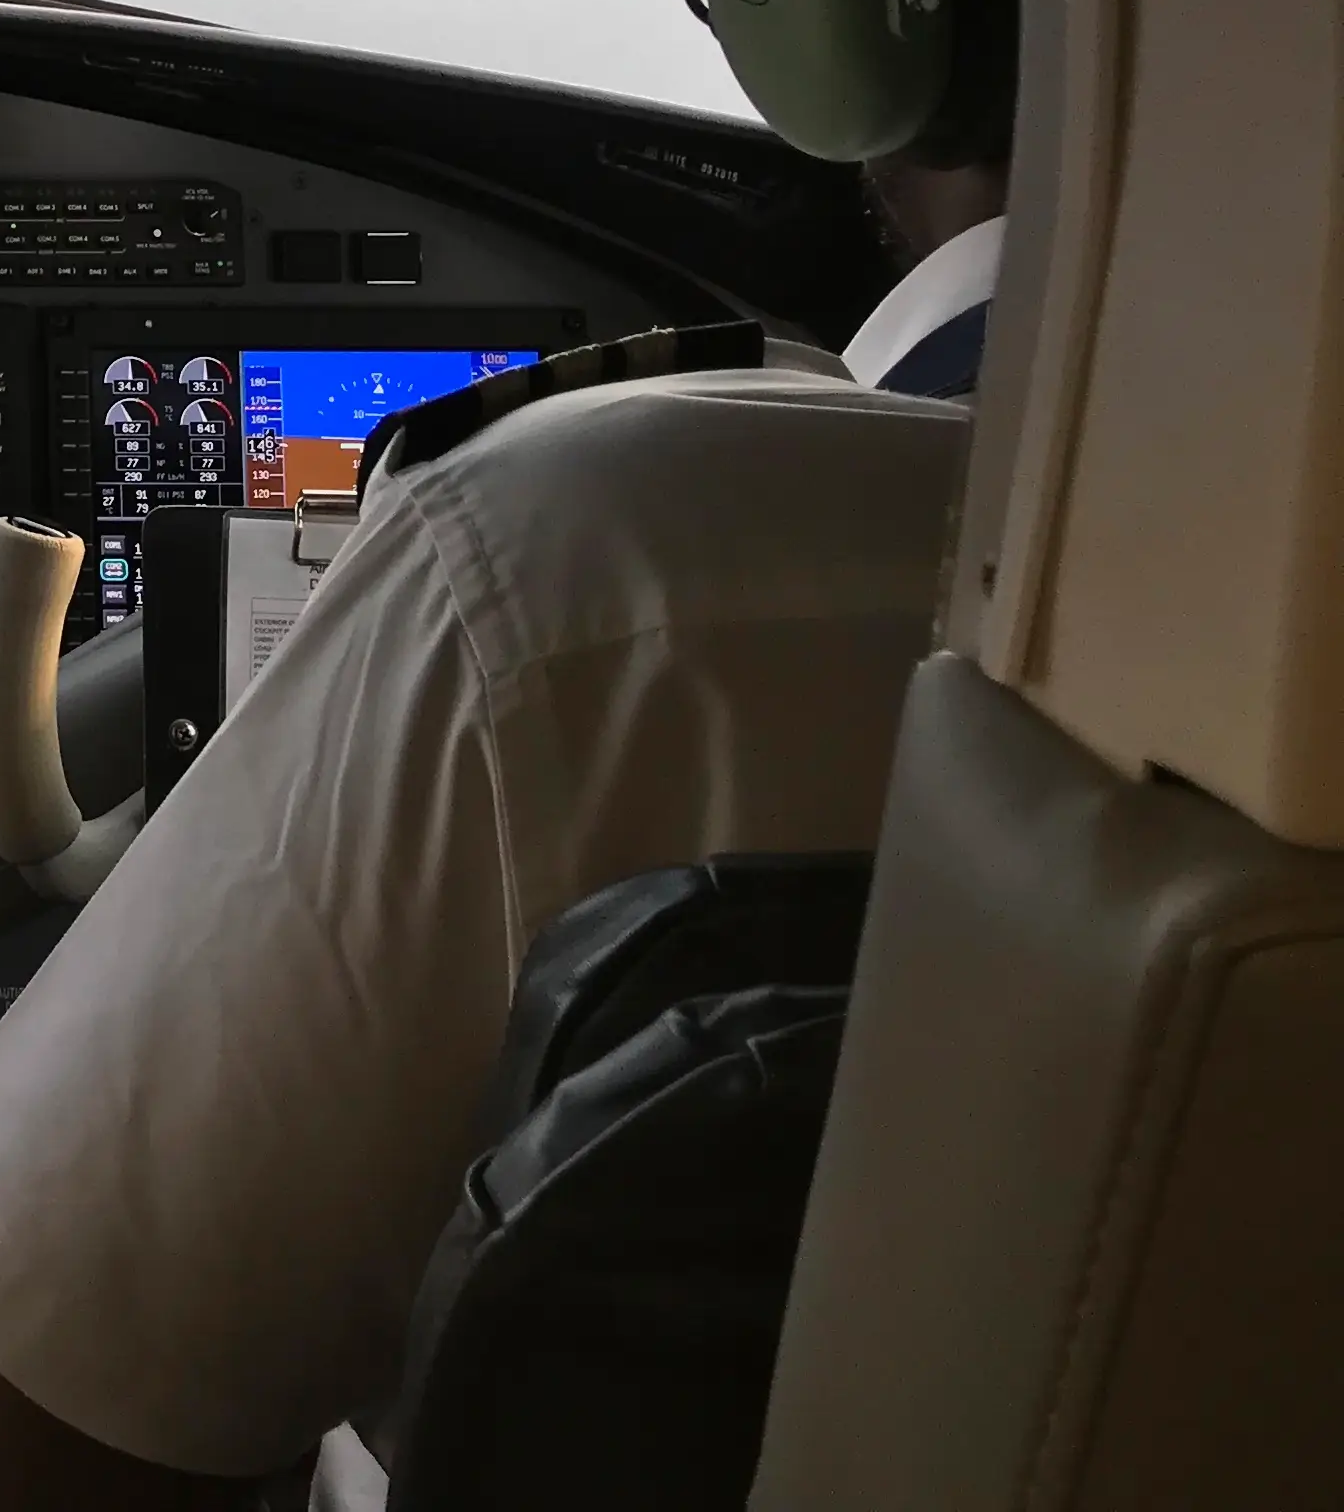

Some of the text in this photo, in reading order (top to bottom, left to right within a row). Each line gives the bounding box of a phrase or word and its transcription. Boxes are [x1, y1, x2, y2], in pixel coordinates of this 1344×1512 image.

[117, 382, 218, 391] 34.8 35.1
[250, 396, 266, 405] 170
[121, 424, 141, 433] 627
[201, 442, 213, 451] 90
[126, 458, 214, 468] 77 77
[124, 472, 217, 481] 290 293
[252, 471, 269, 480] 130
[135, 490, 147, 499] 91
[253, 489, 269, 498] 120
